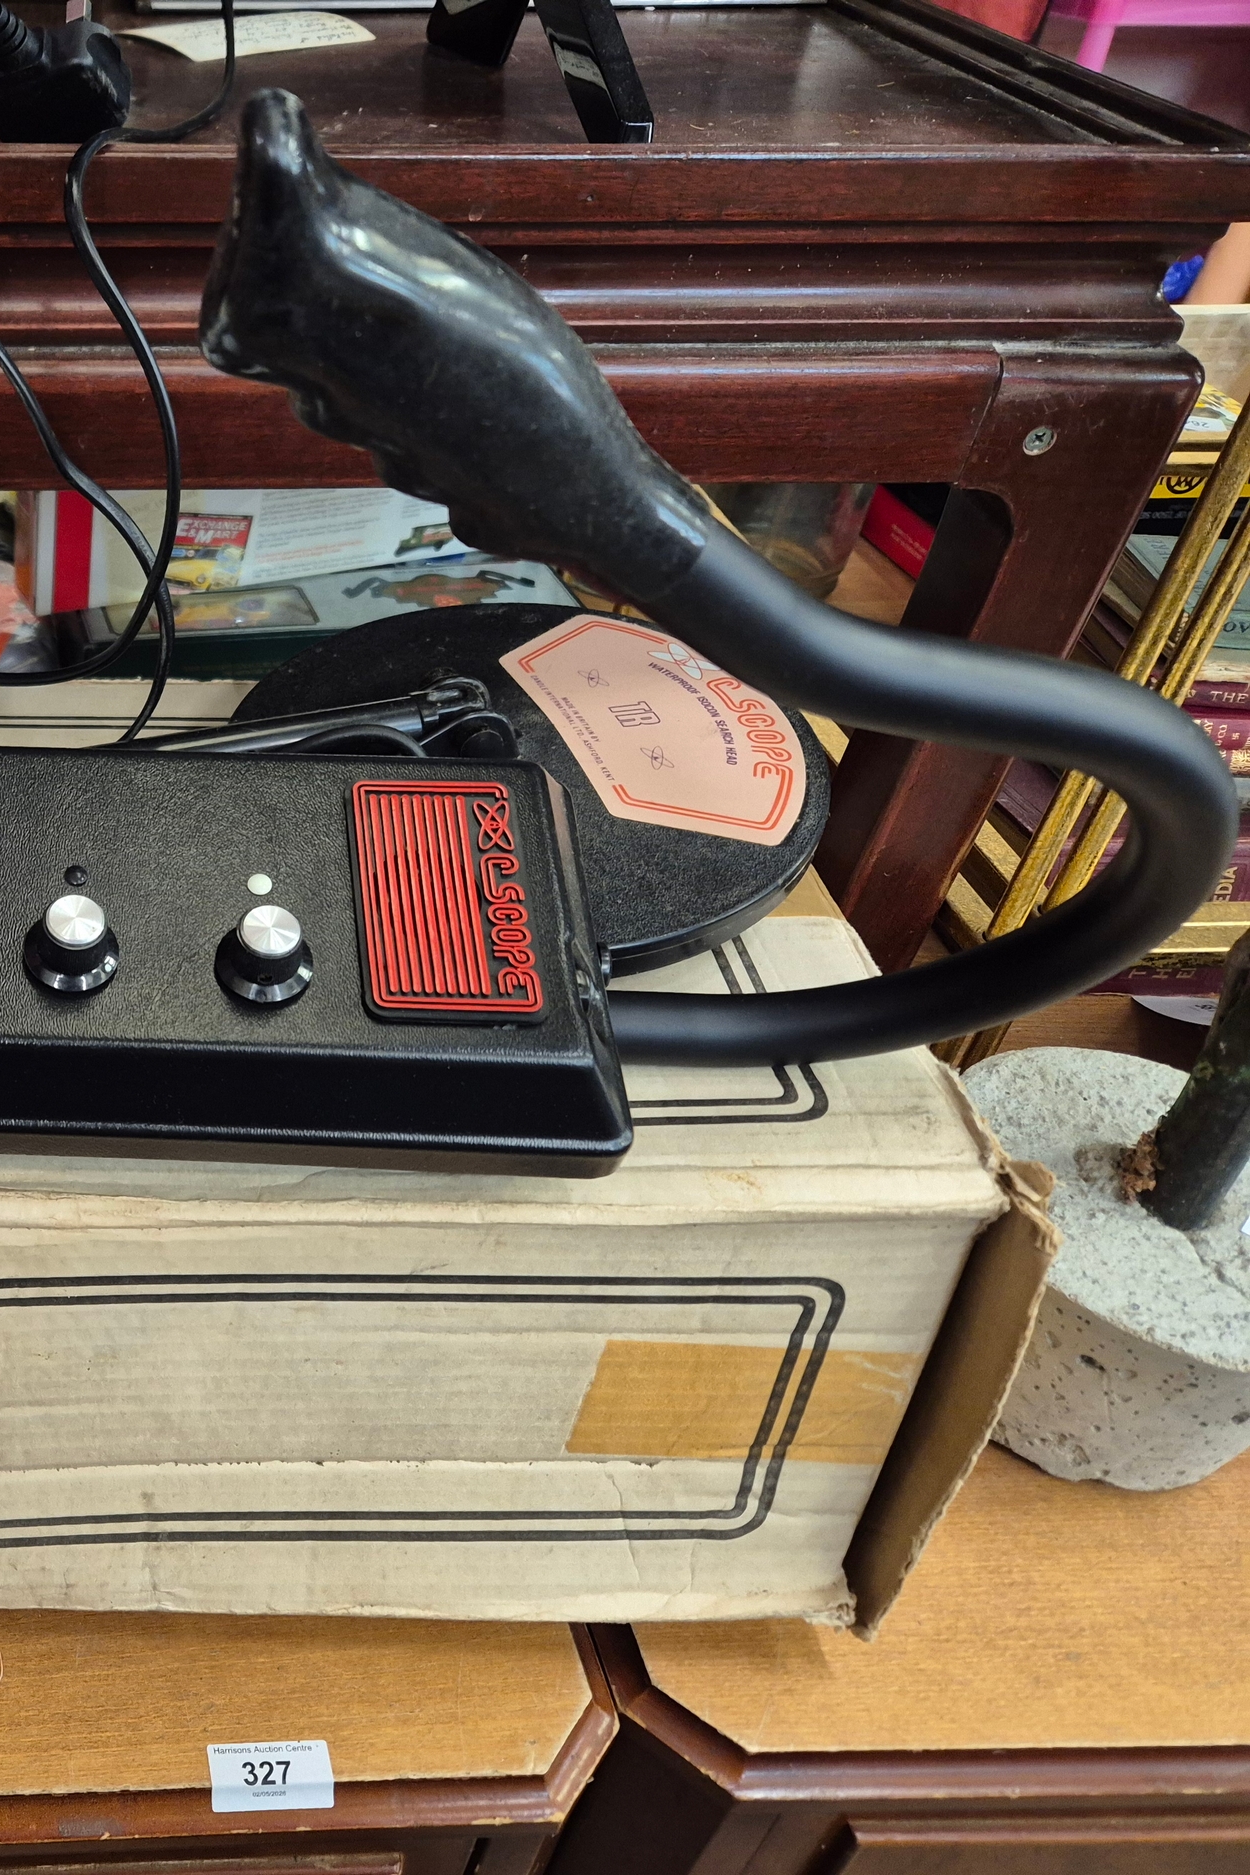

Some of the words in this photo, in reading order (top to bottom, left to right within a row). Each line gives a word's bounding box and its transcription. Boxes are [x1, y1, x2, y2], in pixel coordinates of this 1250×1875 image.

[176, 518, 247, 537] EXCHANGE
[195, 529, 238, 544] MART
[1210, 690, 1249, 704] THE
[648, 662, 701, 695] WATERPROOF
[697, 696, 721, 718] ISOCON
[715, 719, 735, 745] SEARCH
[726, 746, 738, 766] HEAD
[530, 674, 548, 692] CANDLE
[545, 691, 575, 727] INTERNATIONAL
[600, 766, 615, 781] KENT
[575, 715, 596, 736] BRITAIN
[213, 1746, 251, 1755] Harrisons
[254, 1745, 283, 1754] Auction
[286, 1744, 312, 1753] Centre
[242, 1760, 291, 1786] 327
